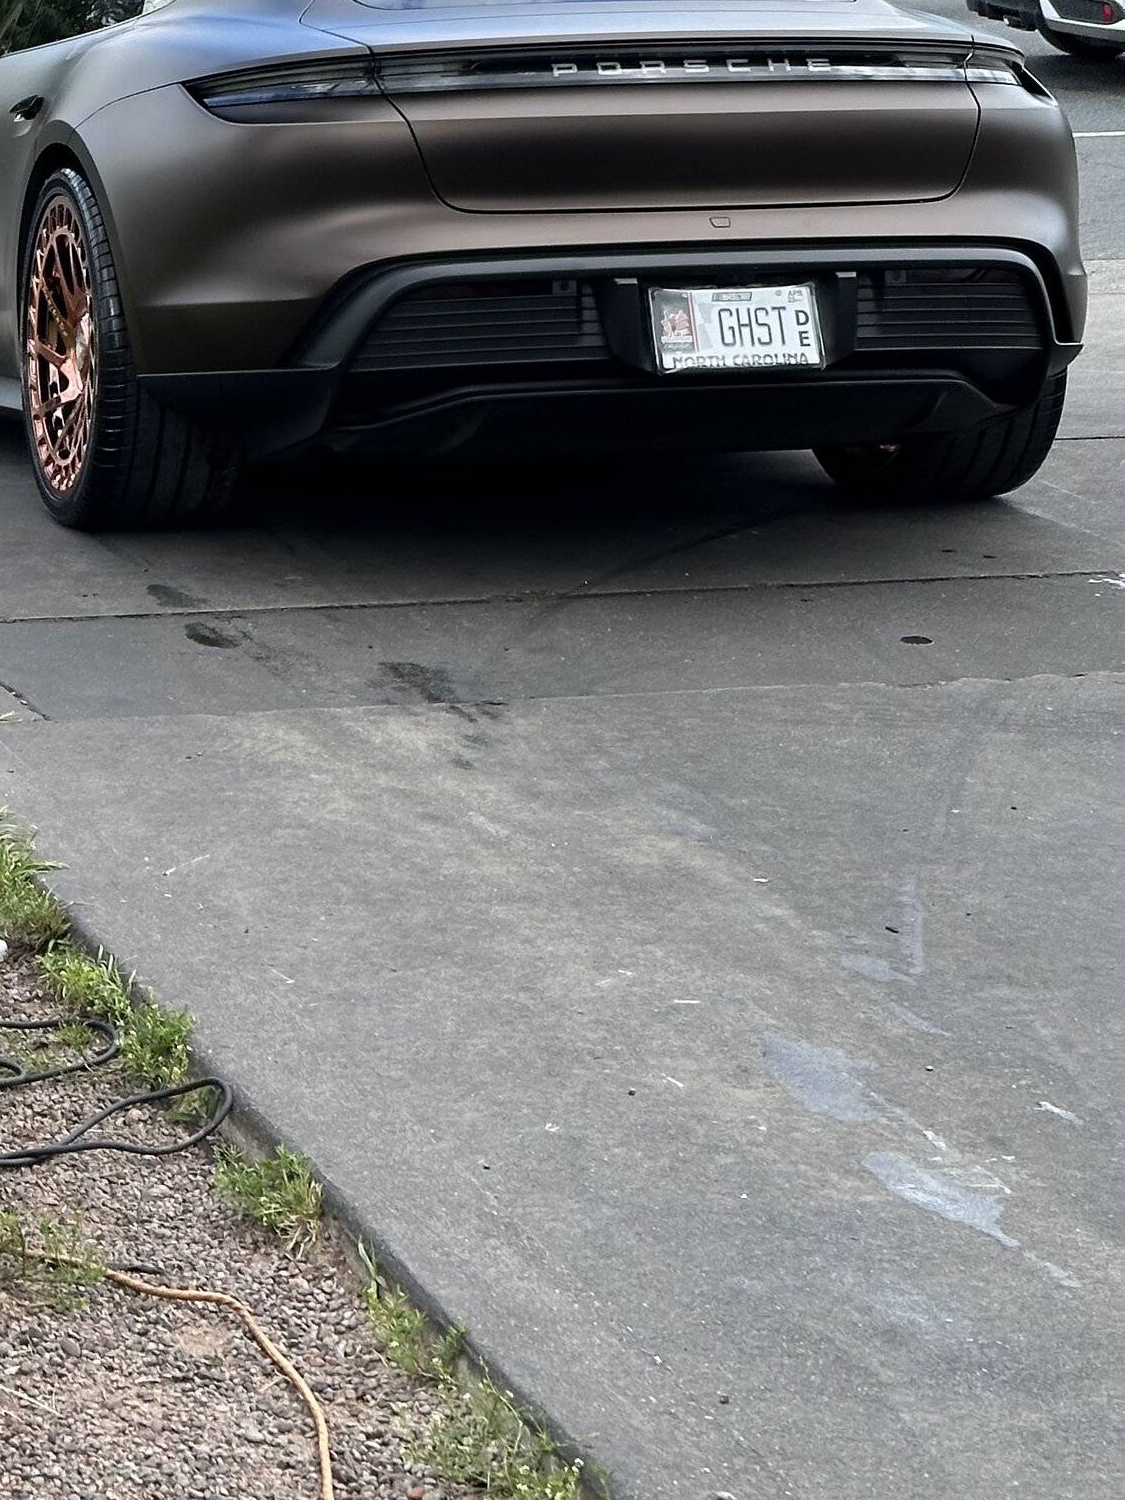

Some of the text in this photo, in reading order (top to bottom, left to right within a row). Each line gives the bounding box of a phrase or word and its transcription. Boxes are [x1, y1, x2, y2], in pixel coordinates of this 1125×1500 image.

[552, 58, 831, 77] PORSCHE
[717, 306, 787, 348] GHST
[672, 352, 809, 369] NORTH CAROLINA
